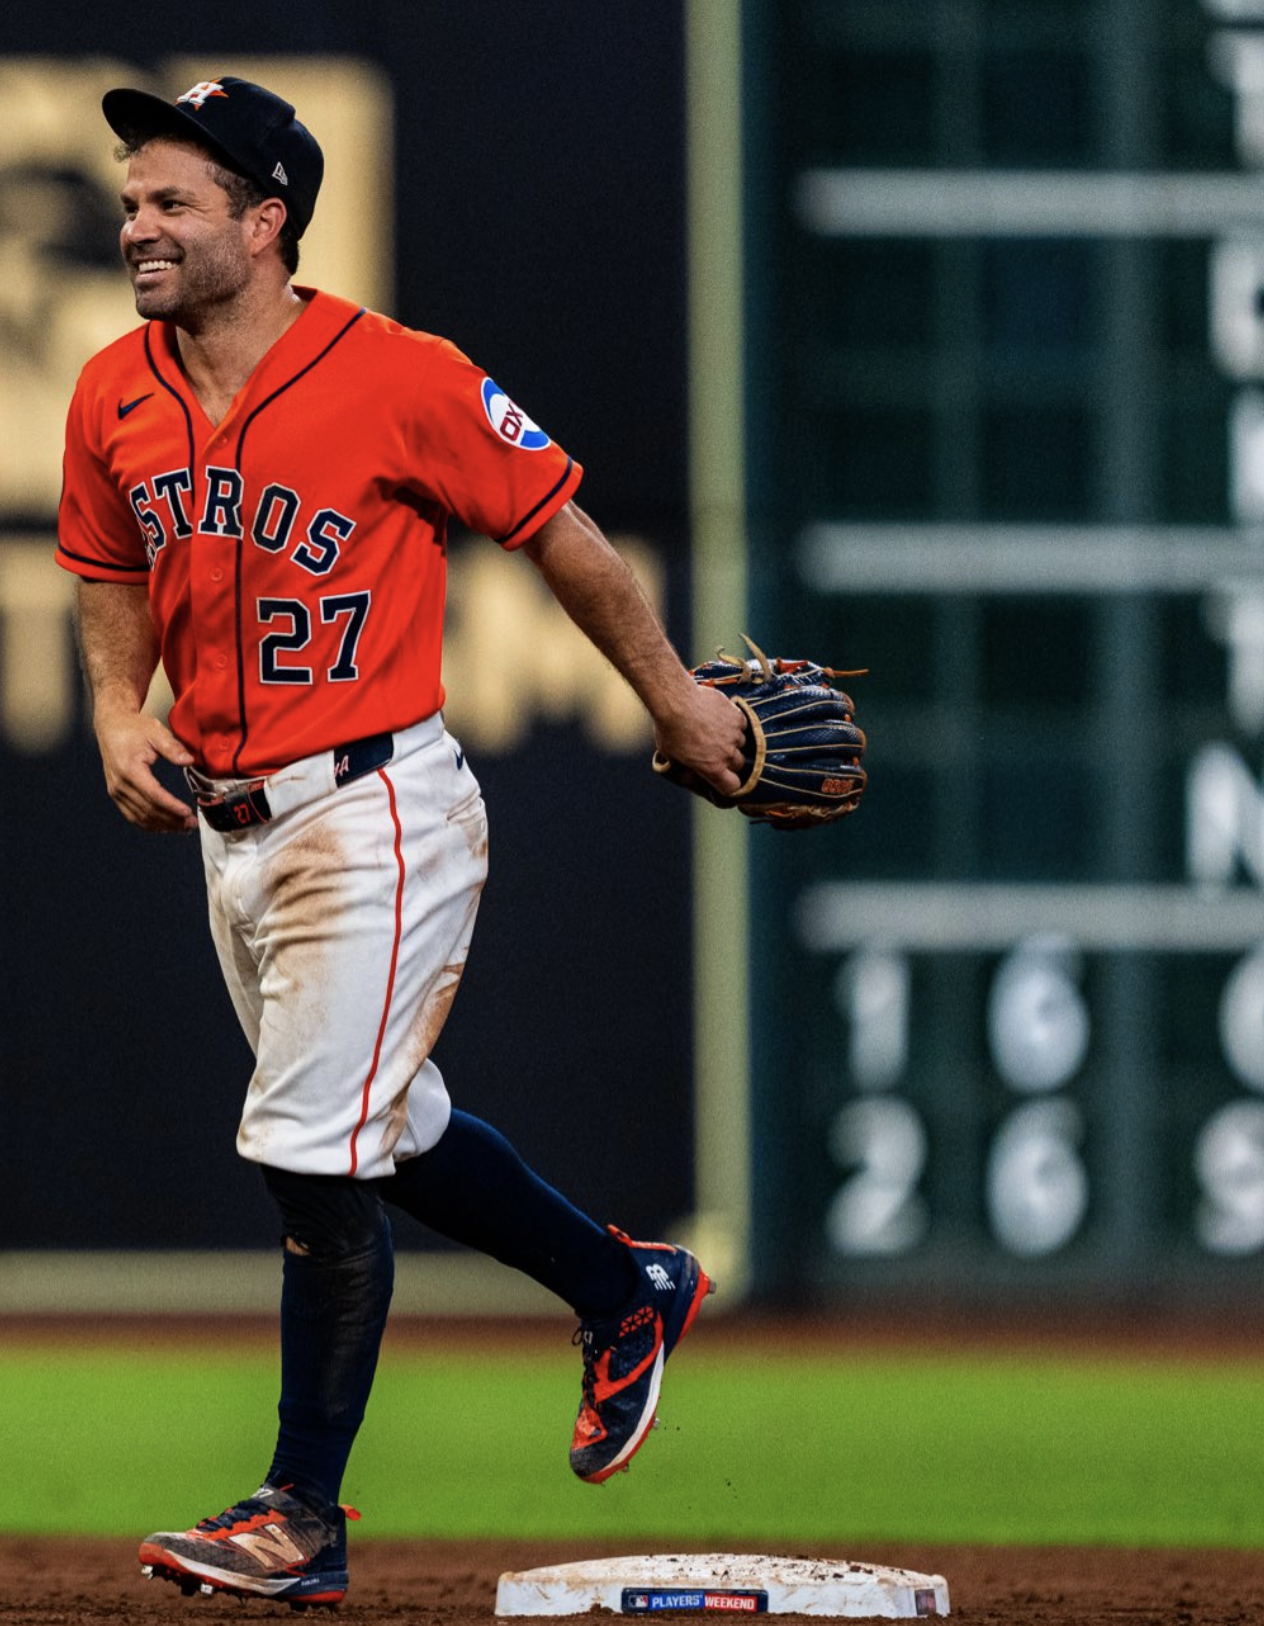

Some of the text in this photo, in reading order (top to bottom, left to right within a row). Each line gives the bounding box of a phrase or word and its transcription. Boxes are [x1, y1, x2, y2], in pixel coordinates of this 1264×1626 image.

[176, 80, 225, 106] H
[499, 401, 524, 442] OX
[130, 465, 357, 577] STROS
[256, 589, 372, 686] 27
[228, 1523, 305, 1569] N
[704, 1595, 755, 1609] WEEKEND
